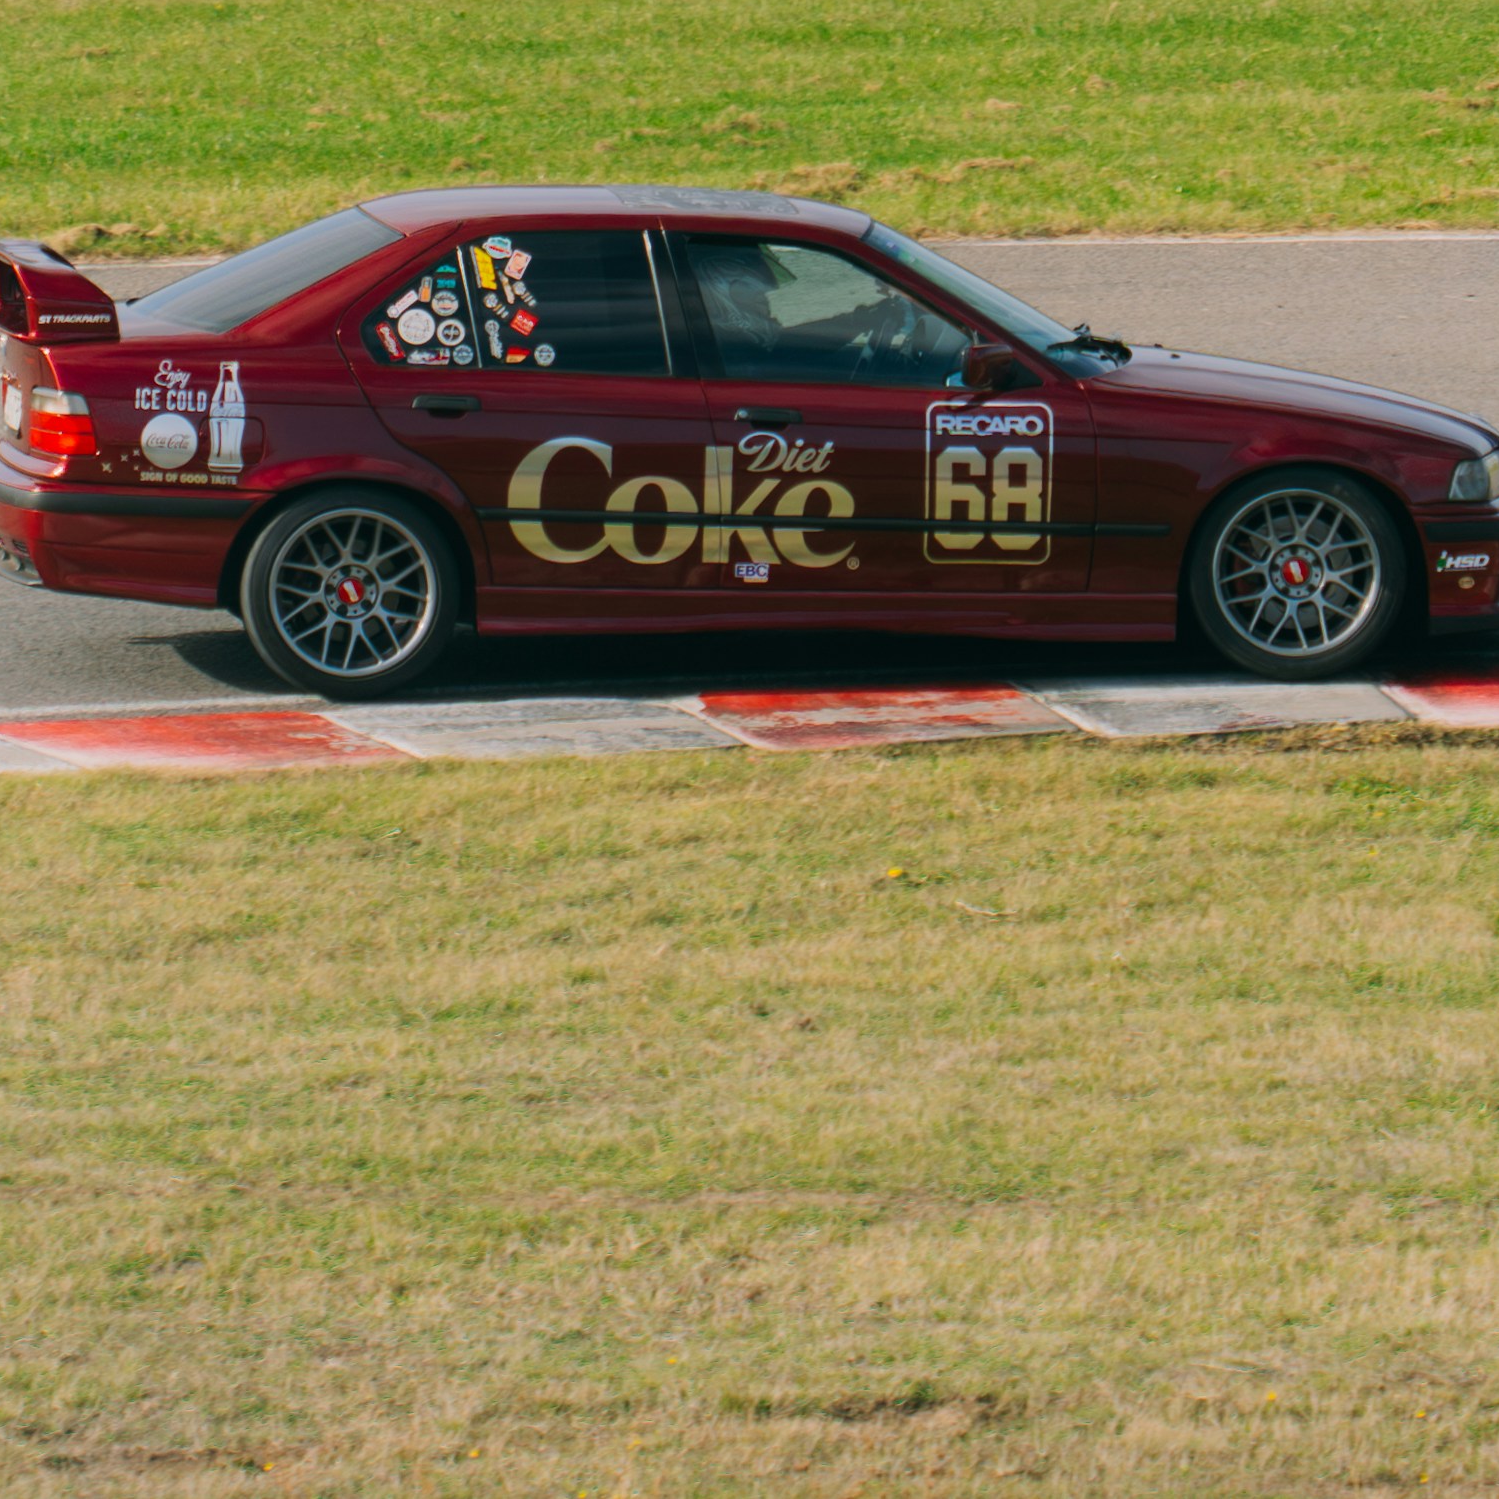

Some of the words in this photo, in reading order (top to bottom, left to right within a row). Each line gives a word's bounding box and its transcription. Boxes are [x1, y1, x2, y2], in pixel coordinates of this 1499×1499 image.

[53, 313, 111, 324] TRACKPARTS
[154, 359, 191, 389] Enjoy
[135, 388, 161, 410] ICE
[166, 390, 208, 412] COLD
[936, 414, 1044, 437] RECARO
[738, 431, 835, 473] Diet
[140, 471, 163, 482] SIGN
[165, 472, 178, 483] OF
[180, 473, 208, 484] GOOD
[211, 474, 238, 486] TASTE
[507, 436, 856, 568] Coke
[934, 446, 1043, 550] 68
[736, 565, 768, 578] EBC
[1445, 554, 1490, 568] HSD
